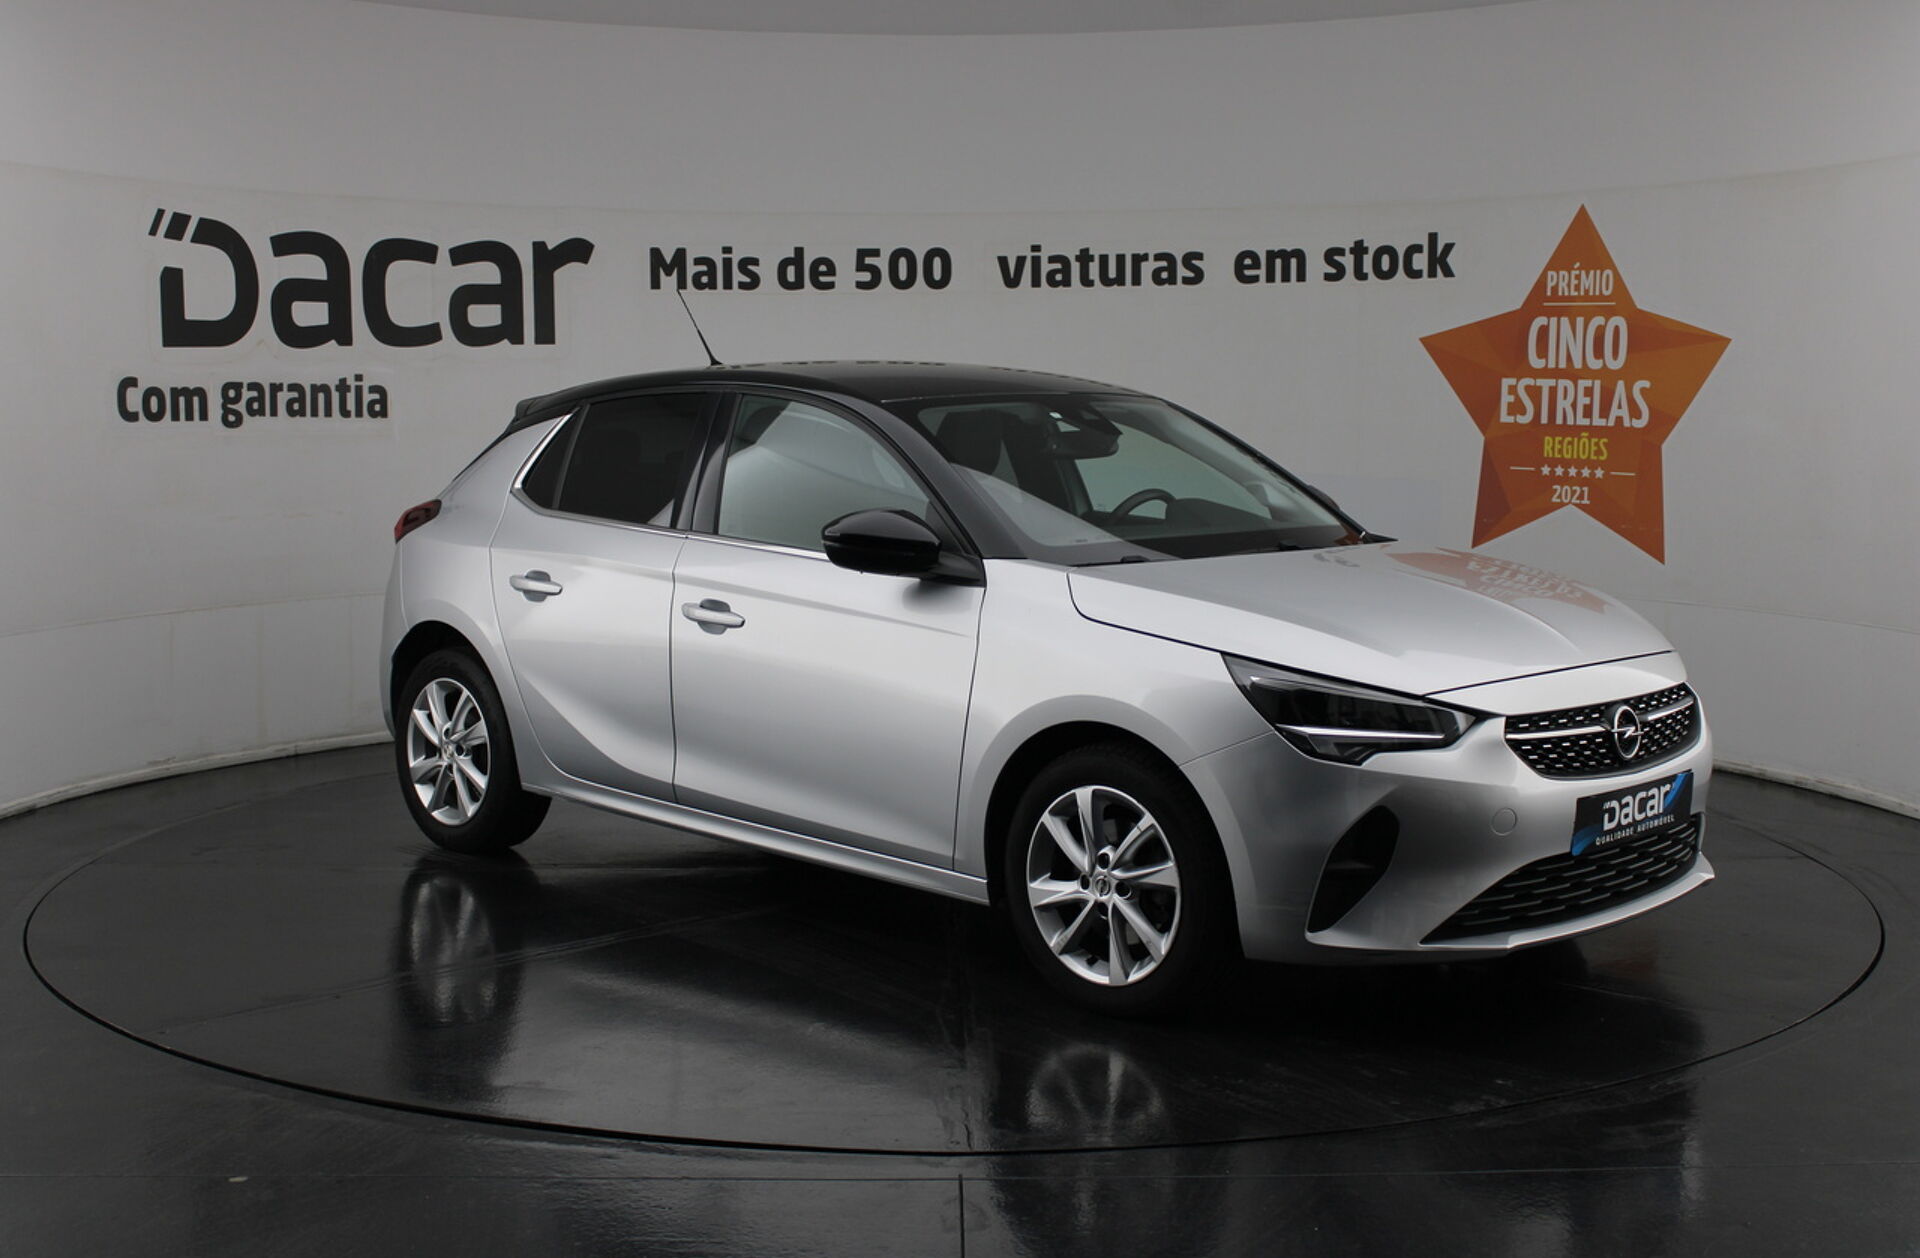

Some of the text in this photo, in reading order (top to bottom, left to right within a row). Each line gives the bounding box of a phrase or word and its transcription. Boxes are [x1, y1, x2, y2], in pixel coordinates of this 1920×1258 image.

[148, 208, 595, 349] Dacar
[649, 232, 1456, 291] Mais de 500 viaturas em stock
[1546, 262, 1614, 296] PRÉMIO
[1527, 316, 1629, 370] CINCO
[117, 374, 389, 429] Com garantia
[1500, 377, 1651, 428] ESTRELAS
[1544, 432, 1608, 460] REGIÕES
[1551, 485, 1591, 504] 2021
[1603, 784, 1671, 831] Dacar
